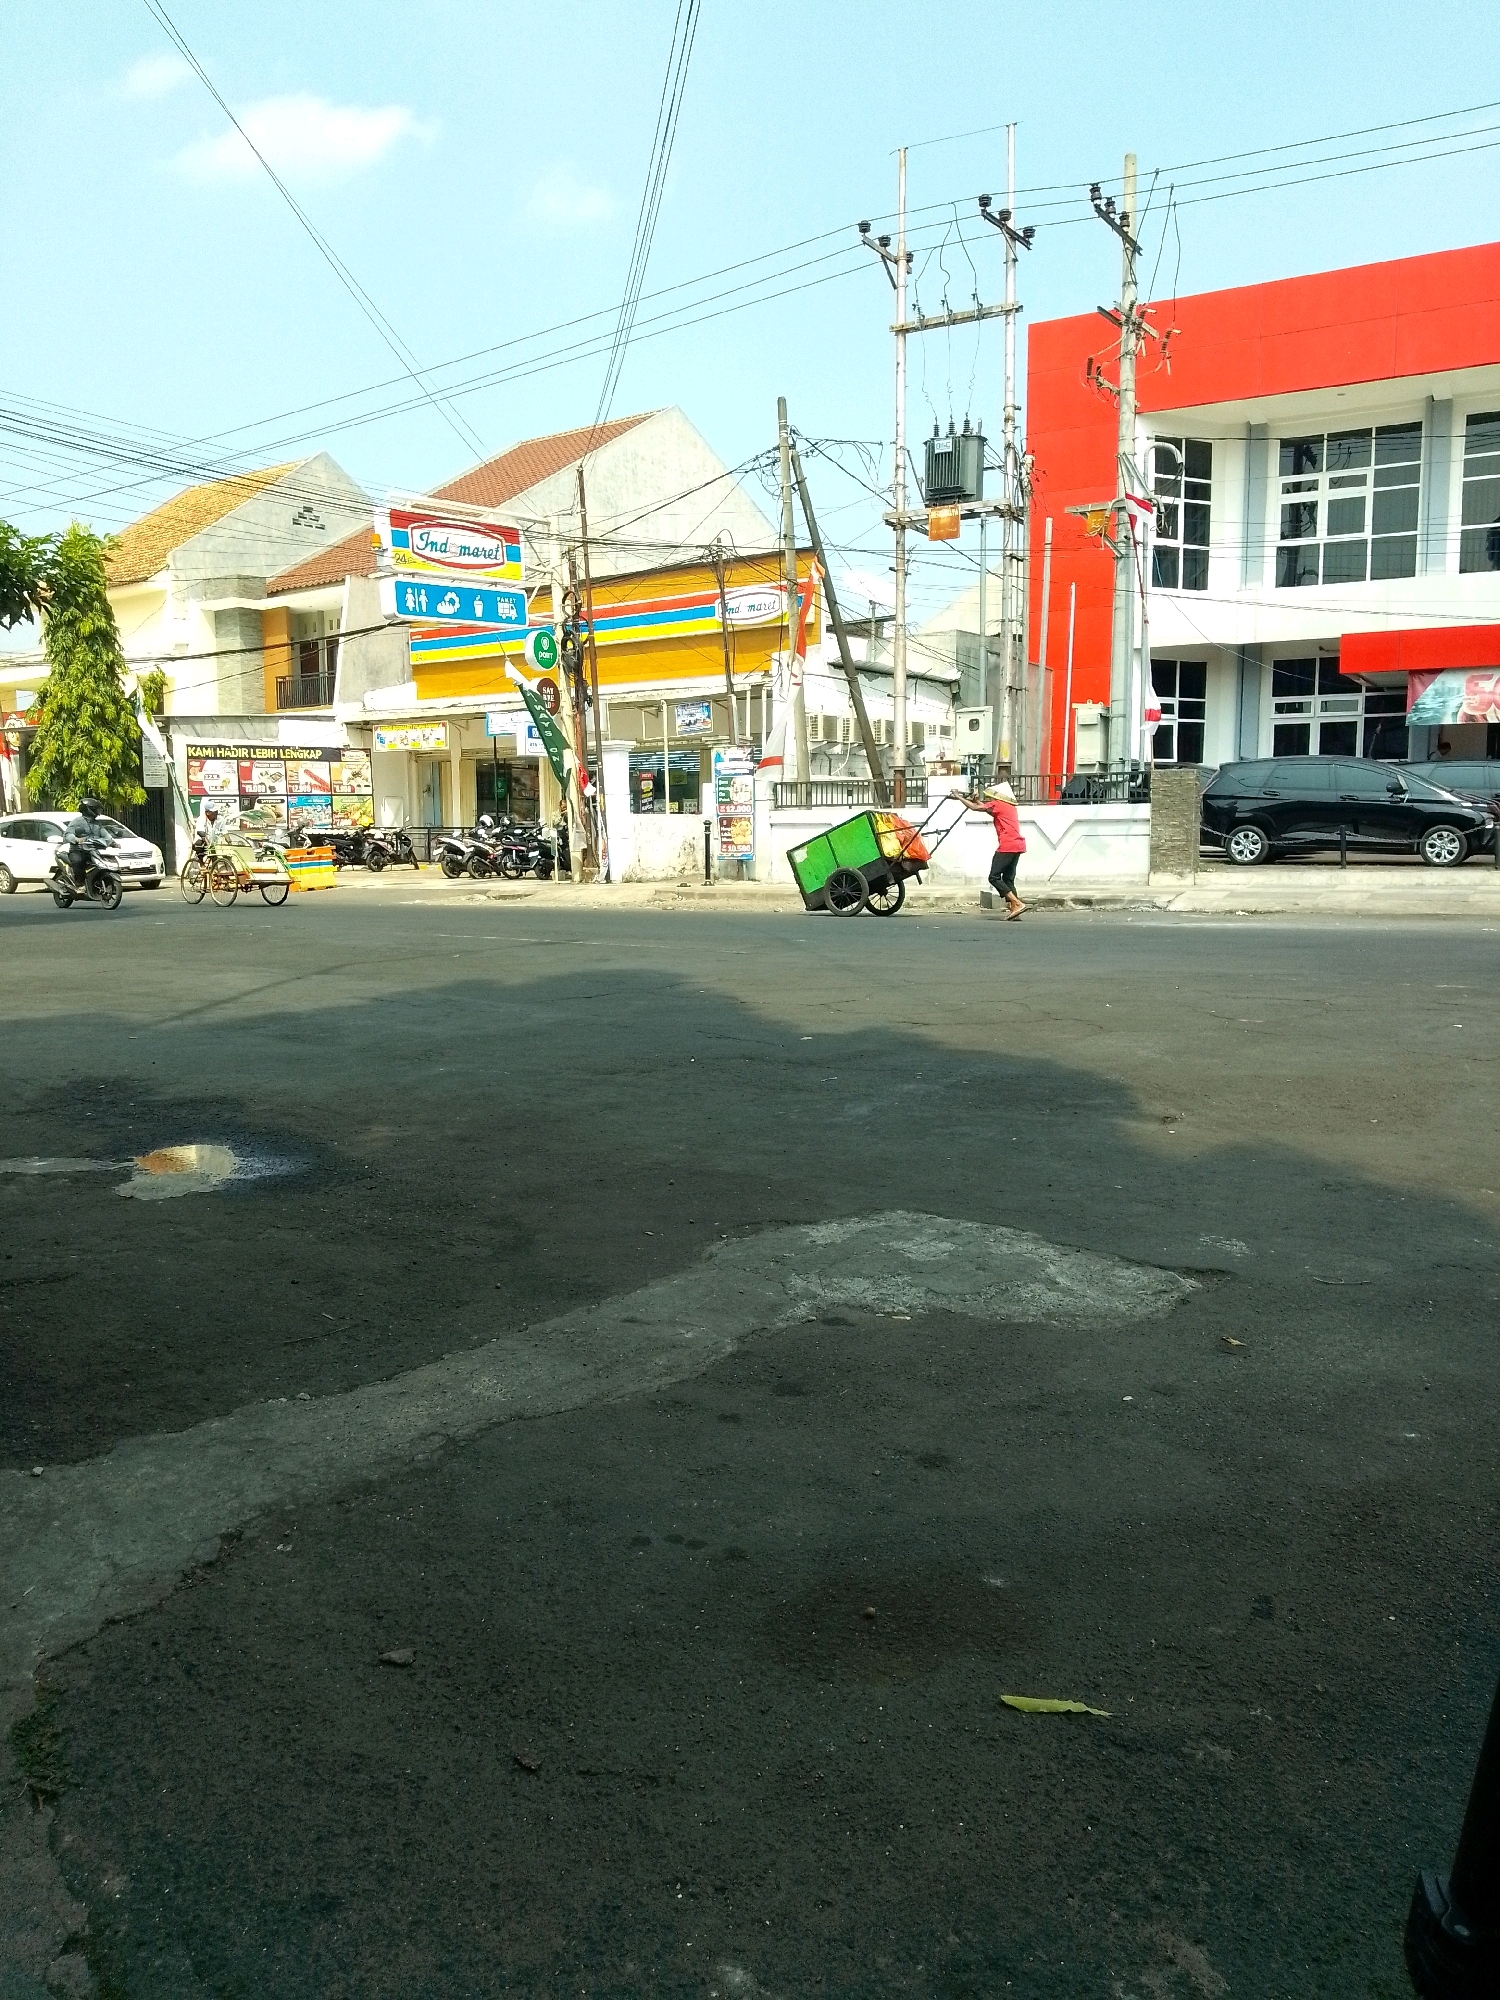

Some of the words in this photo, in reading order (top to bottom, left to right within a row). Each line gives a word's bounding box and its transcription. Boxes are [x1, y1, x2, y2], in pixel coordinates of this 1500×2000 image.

[394, 553, 407, 564] 24
[1464, 673, 1500, 716] 5
[187, 746, 214, 757] KAMI
[216, 747, 249, 758] HADIR
[251, 748, 278, 759] LEBIH
[279, 748, 323, 759] LENGKAP
